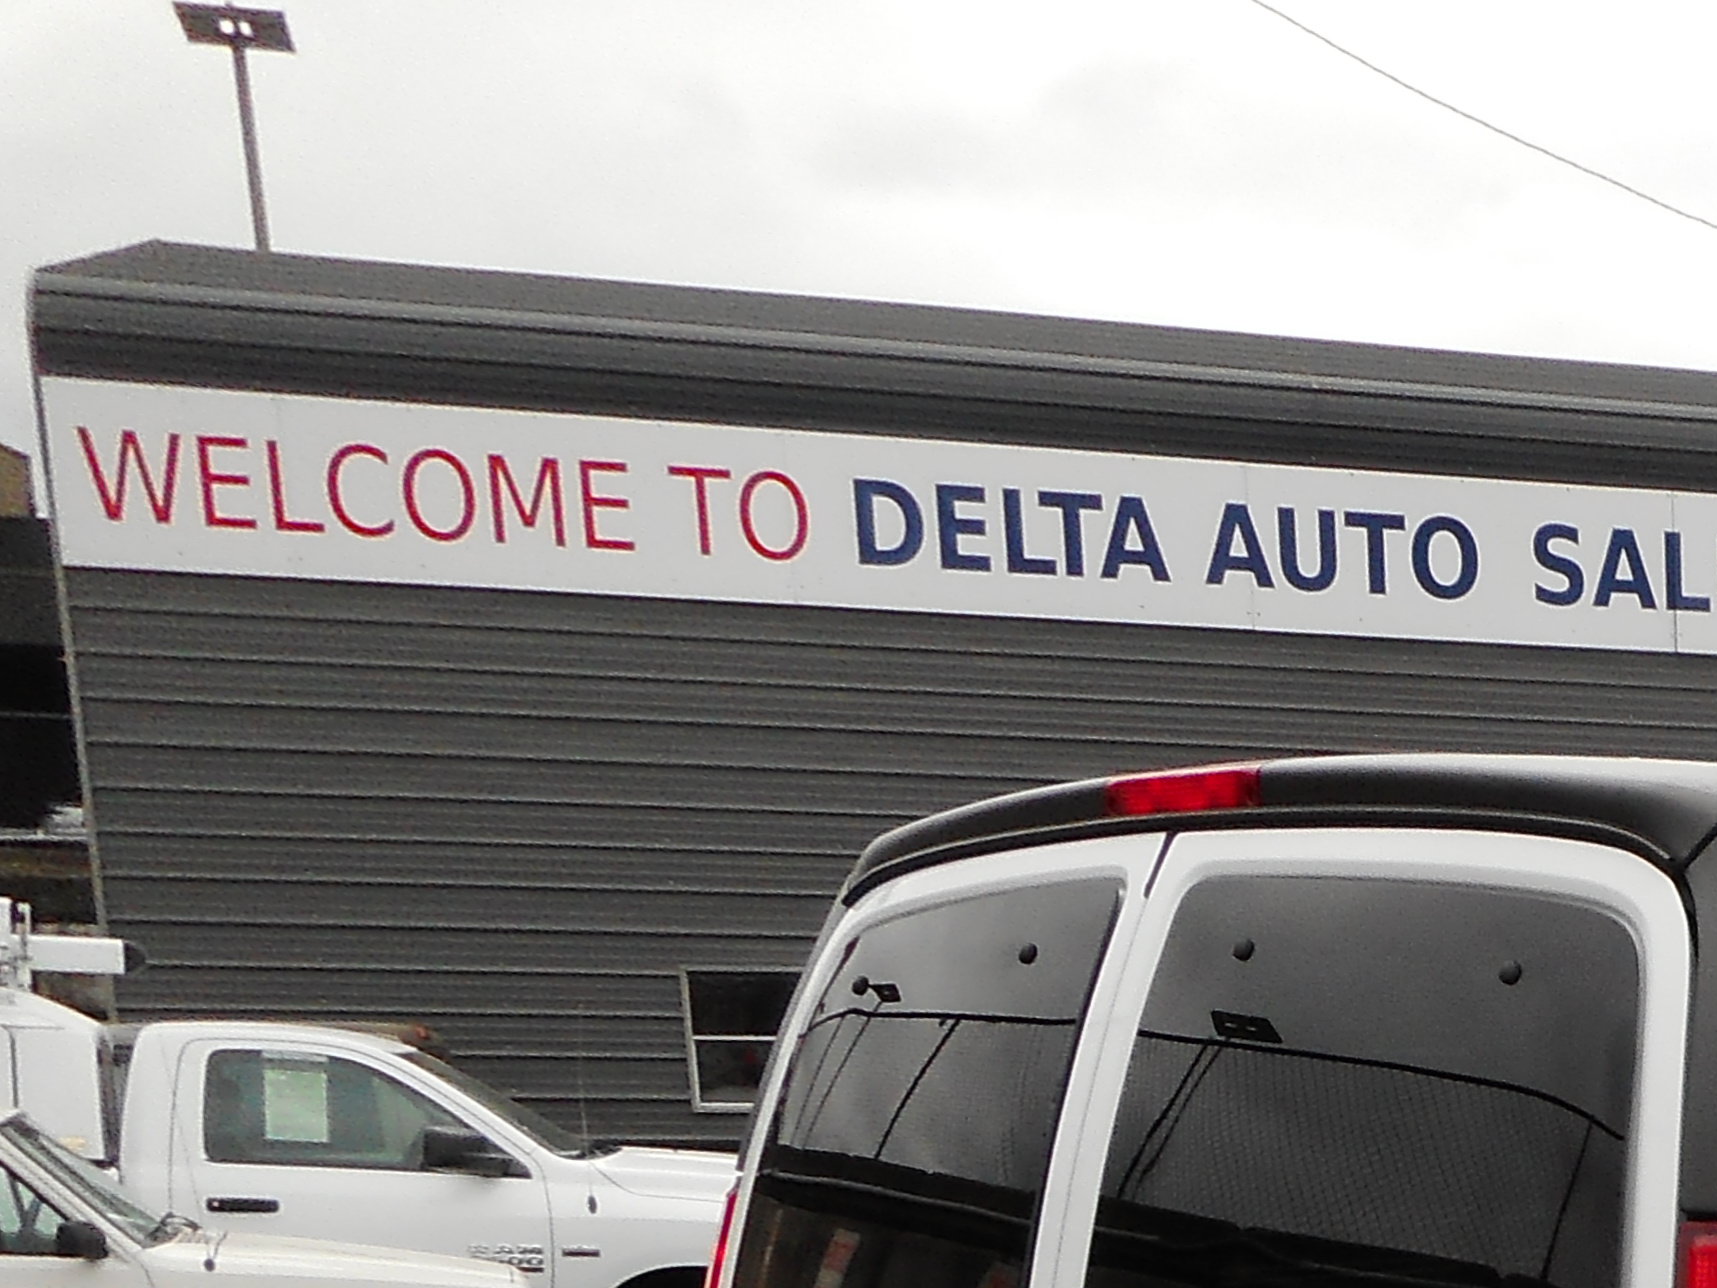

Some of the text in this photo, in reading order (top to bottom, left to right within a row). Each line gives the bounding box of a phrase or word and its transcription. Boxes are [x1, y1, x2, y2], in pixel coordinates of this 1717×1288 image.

[77, 425, 636, 552] WELCOME
[666, 465, 810, 561] TO
[853, 478, 1171, 583] DELTA
[1206, 503, 1479, 600] AUTO
